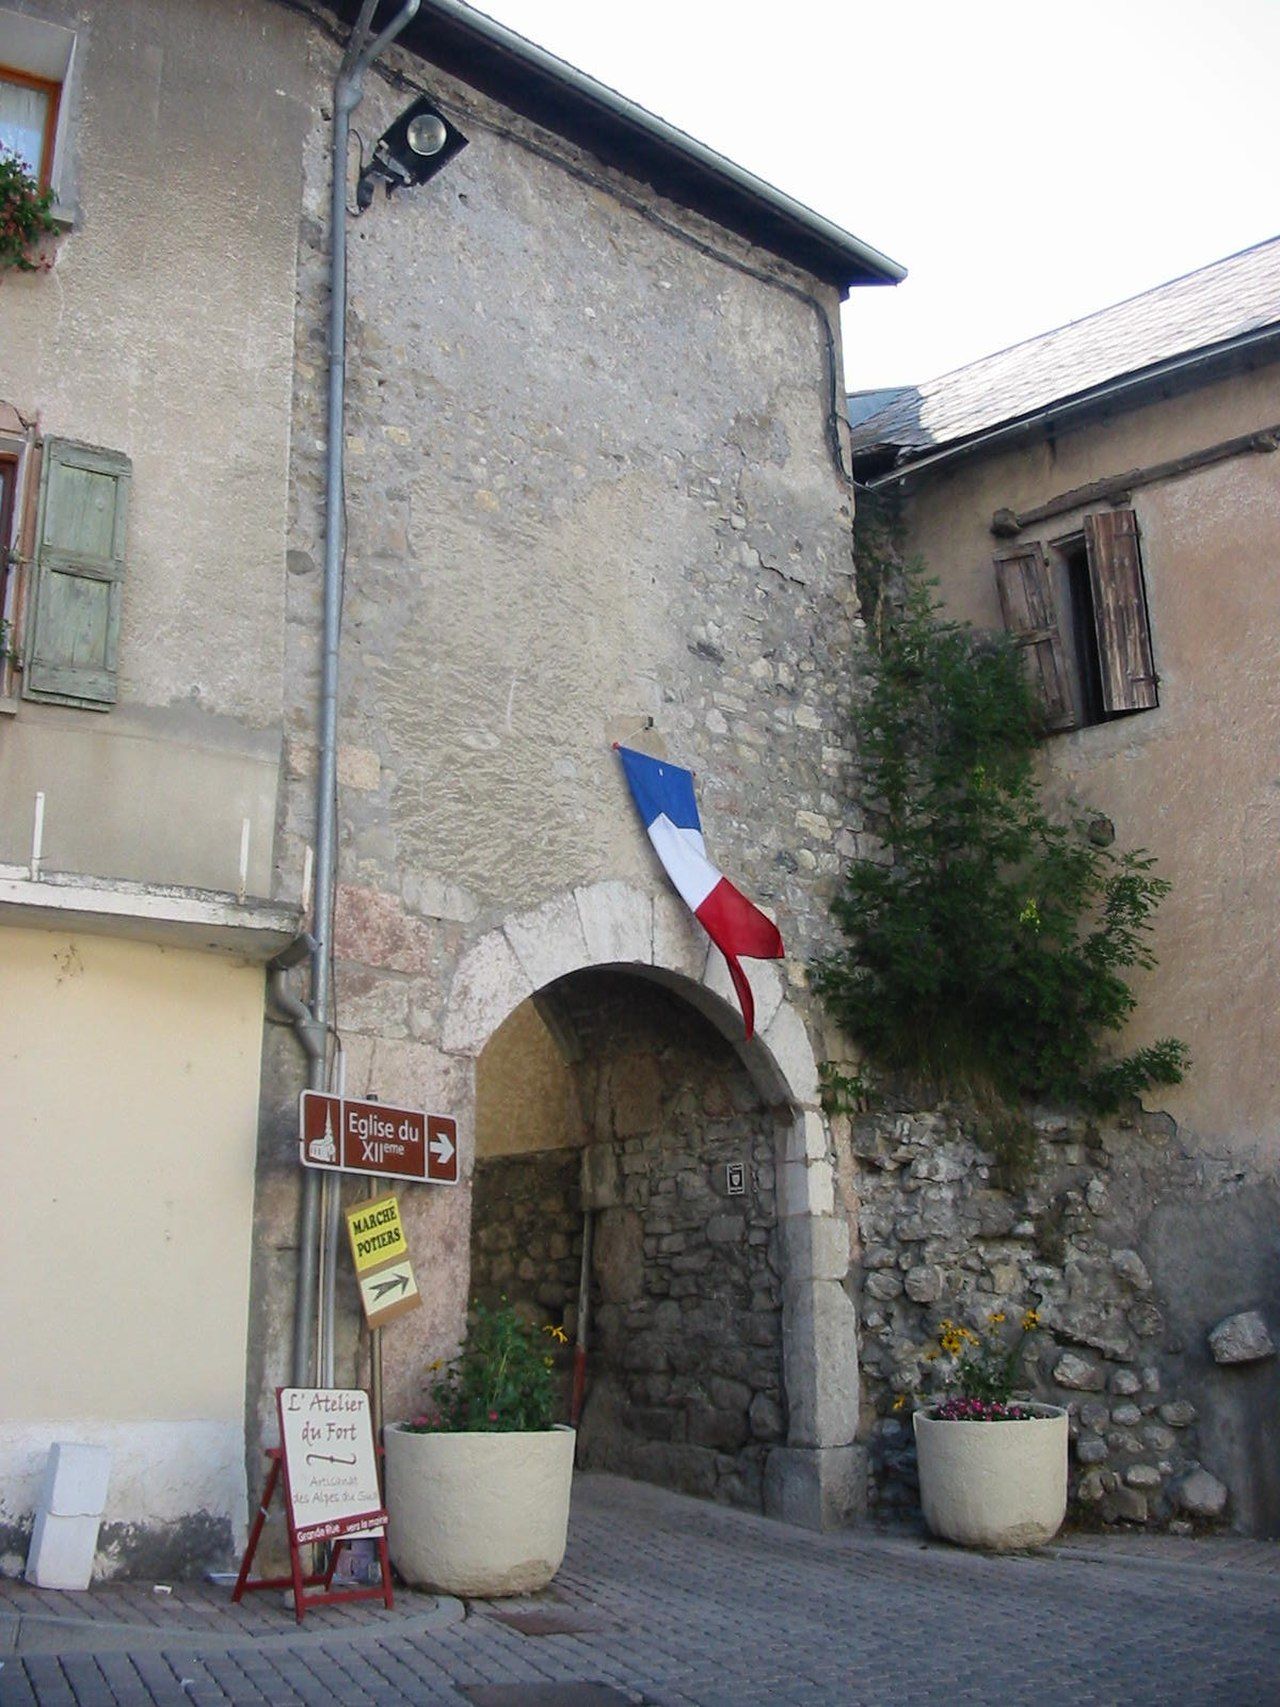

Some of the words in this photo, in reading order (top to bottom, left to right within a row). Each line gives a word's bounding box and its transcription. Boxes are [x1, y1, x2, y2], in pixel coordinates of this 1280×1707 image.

[349, 1112, 394, 1140] Eglise
[398, 1120, 419, 1143] du
[356, 1227, 401, 1258] POTIERS
[301, 1421, 322, 1447] du
[325, 1422, 358, 1441] Fort
[297, 1526, 326, 1542] Grande
